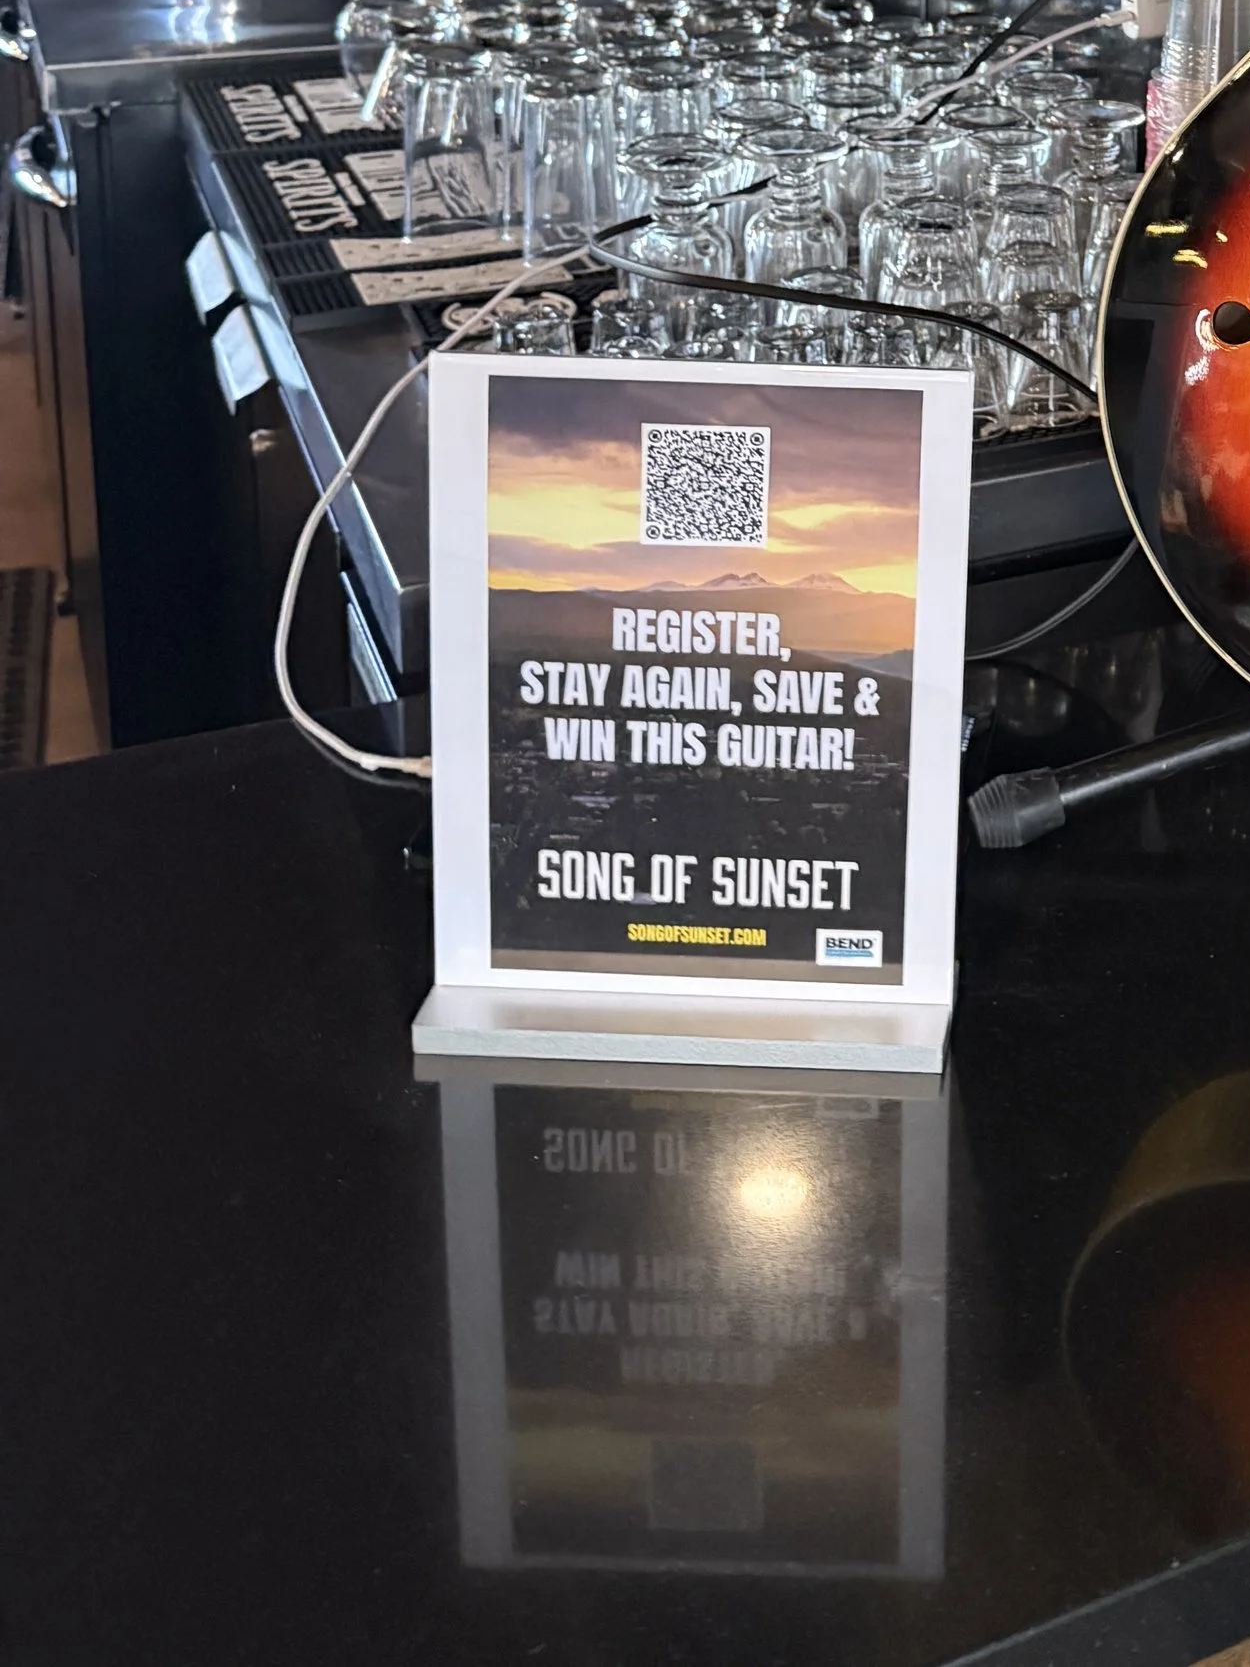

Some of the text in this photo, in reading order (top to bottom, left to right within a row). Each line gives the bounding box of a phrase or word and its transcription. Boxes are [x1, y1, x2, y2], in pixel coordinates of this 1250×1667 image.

[220, 84, 301, 143] SPIRITS
[262, 158, 358, 232] SPIRITS
[612, 608, 792, 662] REGISTER,
[520, 660, 880, 717] STAY AGAIN, SAVE &
[544, 717, 856, 771] WIN THIS GUITAR!
[537, 848, 859, 911] SONG OF SUNSET
[627, 923, 767, 947] SONGOFSUNSET.COM
[825, 937, 874, 950] BEND
